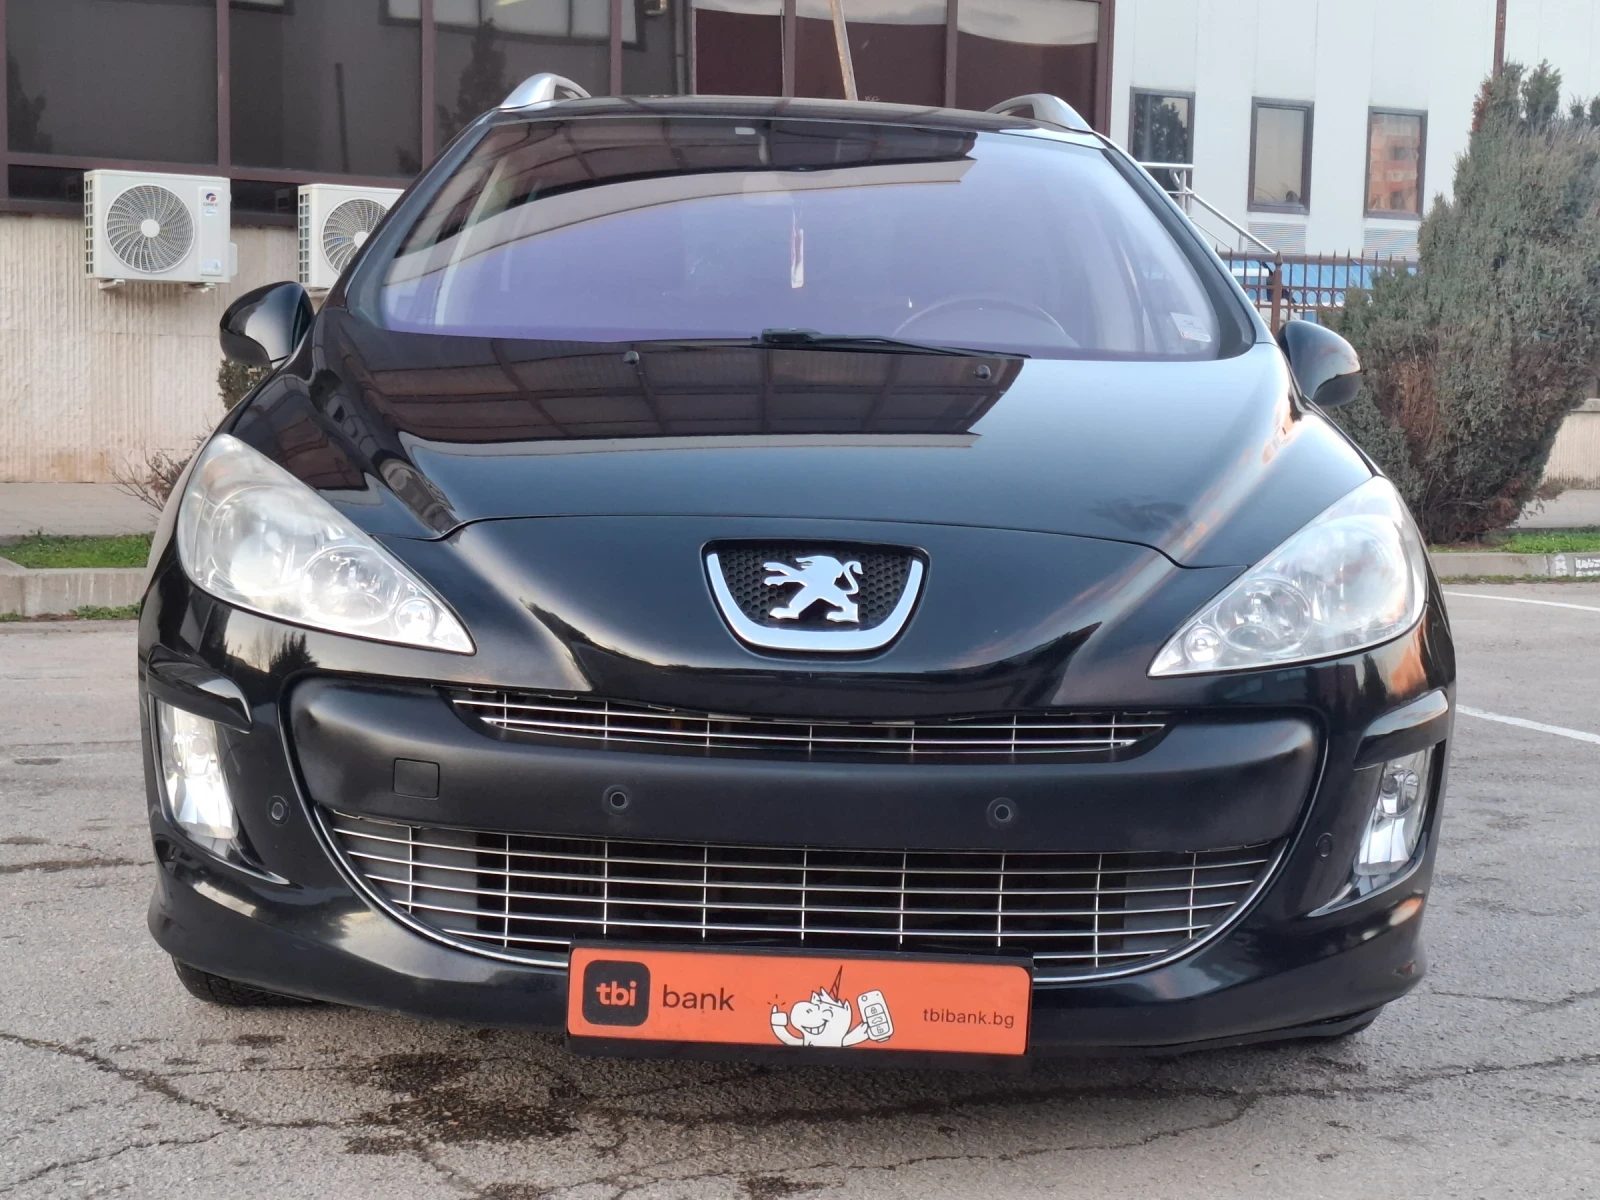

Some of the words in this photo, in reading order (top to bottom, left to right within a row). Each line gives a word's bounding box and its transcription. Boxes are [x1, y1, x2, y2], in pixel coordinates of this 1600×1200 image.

[596, 981, 637, 1006] tbi
[662, 984, 735, 1011] bank
[923, 1008, 1015, 1029] tbibank.bg
